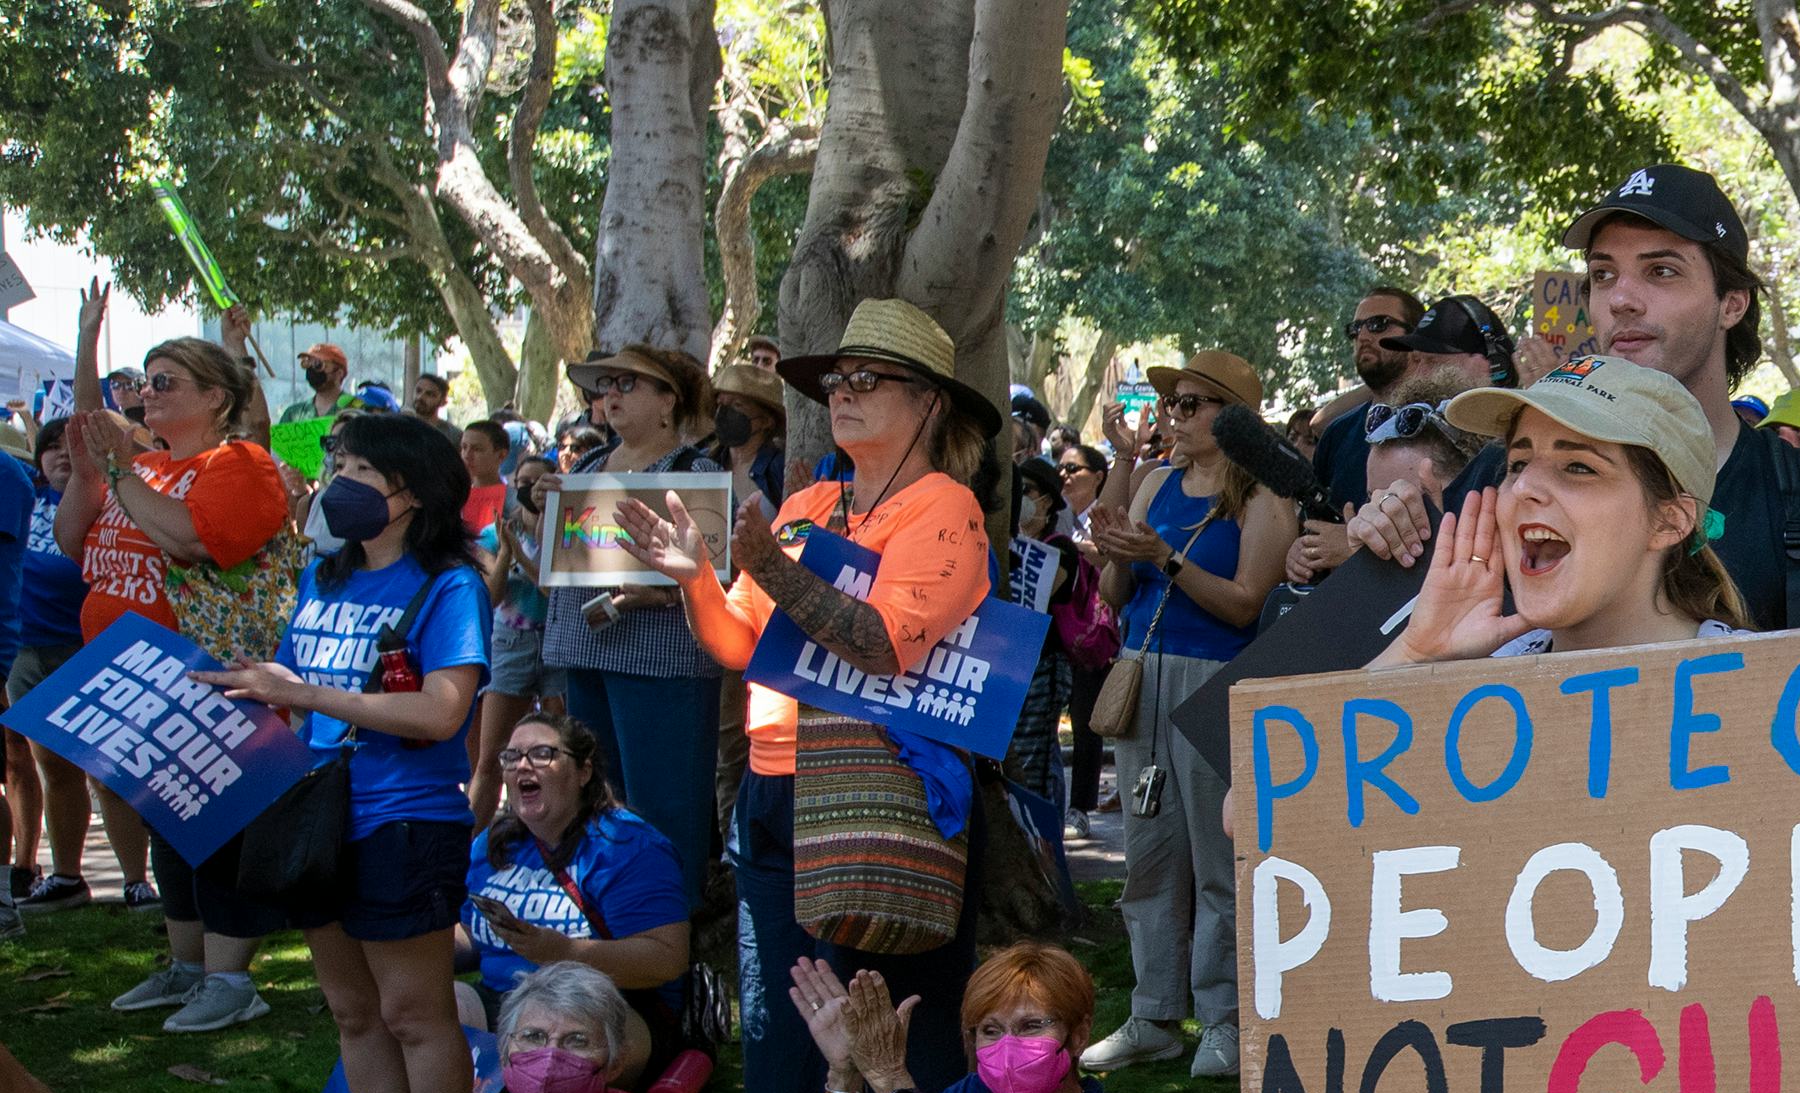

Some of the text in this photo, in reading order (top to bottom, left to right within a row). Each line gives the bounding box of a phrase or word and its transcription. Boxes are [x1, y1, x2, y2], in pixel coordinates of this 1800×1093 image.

[1586, 384, 1617, 402] PARK
[98, 529, 120, 547] NOT
[293, 598, 405, 636] MARCH
[332, 639, 381, 673] OU
[793, 641, 919, 710] LIVES
[112, 639, 257, 750] MARCH
[46, 695, 166, 779] LIVES
[80, 667, 242, 796] FOR OUR
